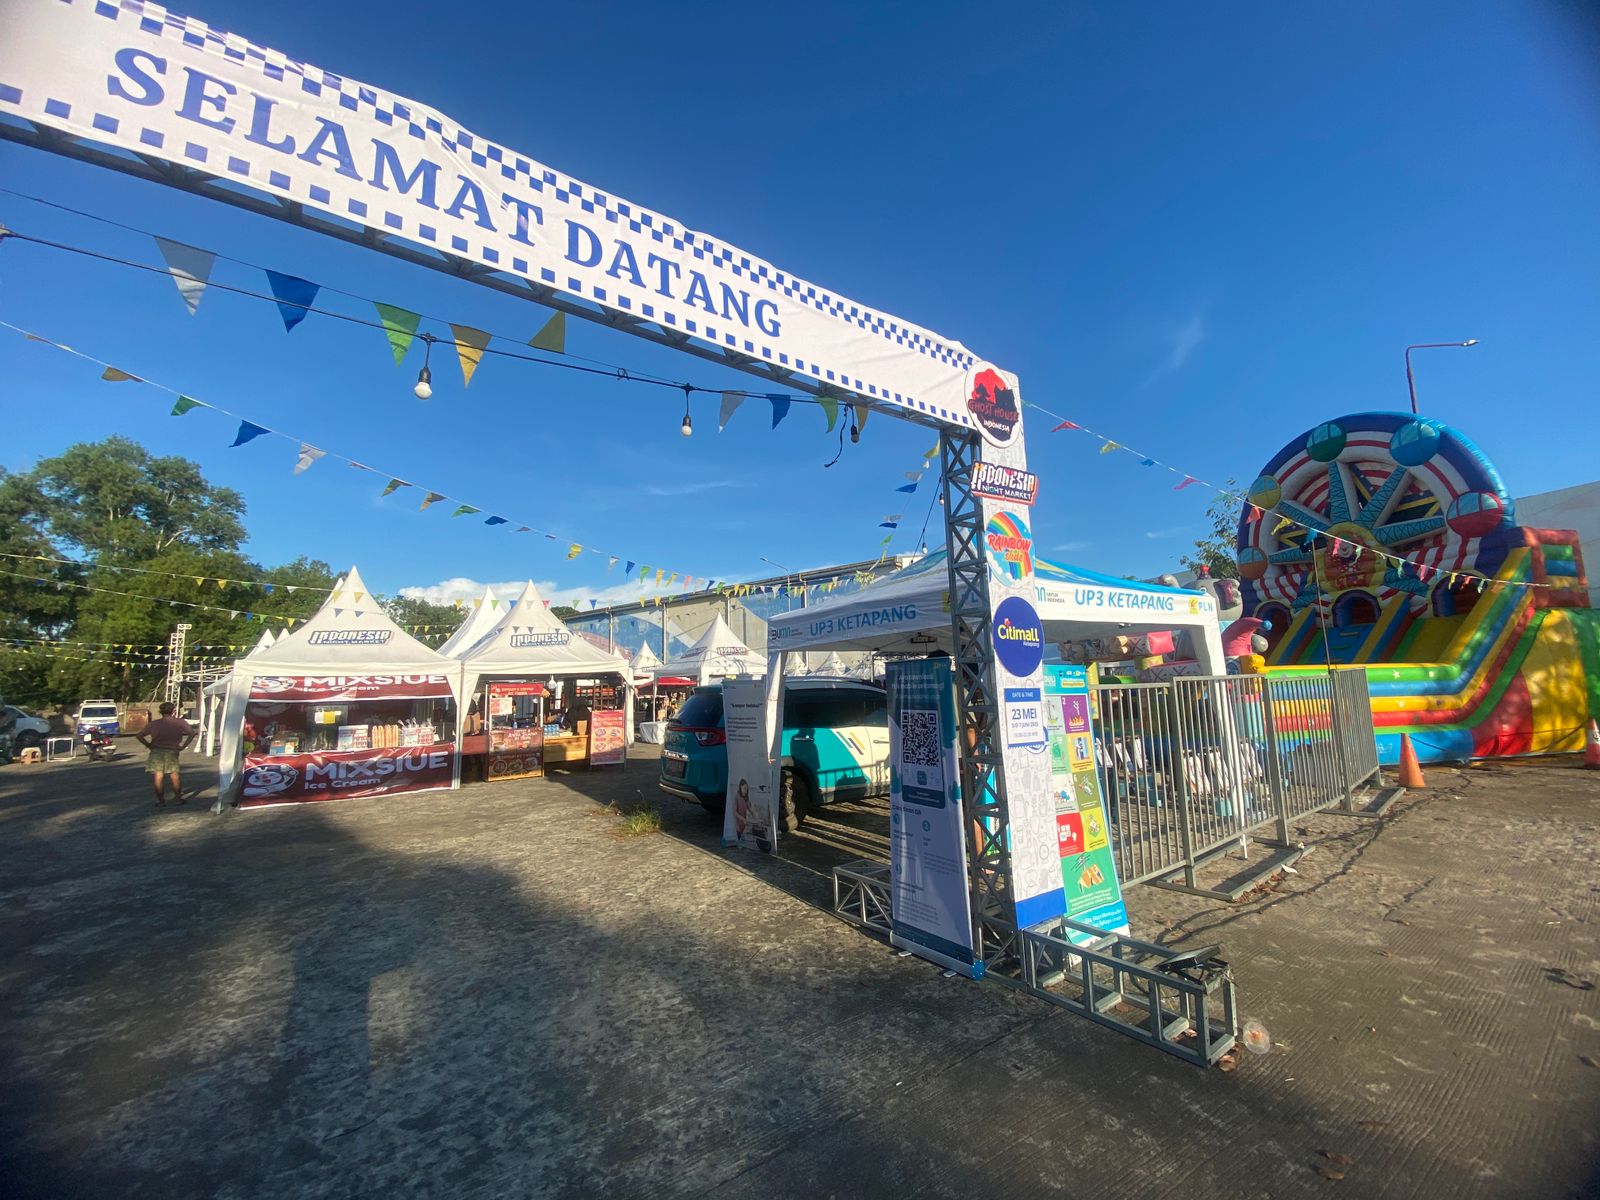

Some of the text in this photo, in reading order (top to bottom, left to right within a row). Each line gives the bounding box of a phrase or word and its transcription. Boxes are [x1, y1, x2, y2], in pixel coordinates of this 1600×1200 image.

[107, 48, 782, 338] SELAMAT DATANG
[968, 399, 1019, 421] GHOST HOUSE
[983, 418, 1010, 432] INDONESIA
[971, 462, 1035, 492] INDONESIA
[982, 484, 1031, 500] NIGHT MARKET
[987, 534, 1031, 552] RAINBOW
[1005, 549, 1024, 562] slide
[1074, 588, 1174, 611] UP3 KETAPANG
[1198, 600, 1213, 612] PLN
[809, 620, 834, 637] UP3
[837, 604, 917, 631] KETAPANG
[997, 623, 1040, 642] Citimall
[331, 684, 380, 692] Cream
[1011, 708, 1037, 720] 23 MEI
[305, 750, 449, 781] MIXSIUE
[304, 777, 381, 790] Ice Cream
